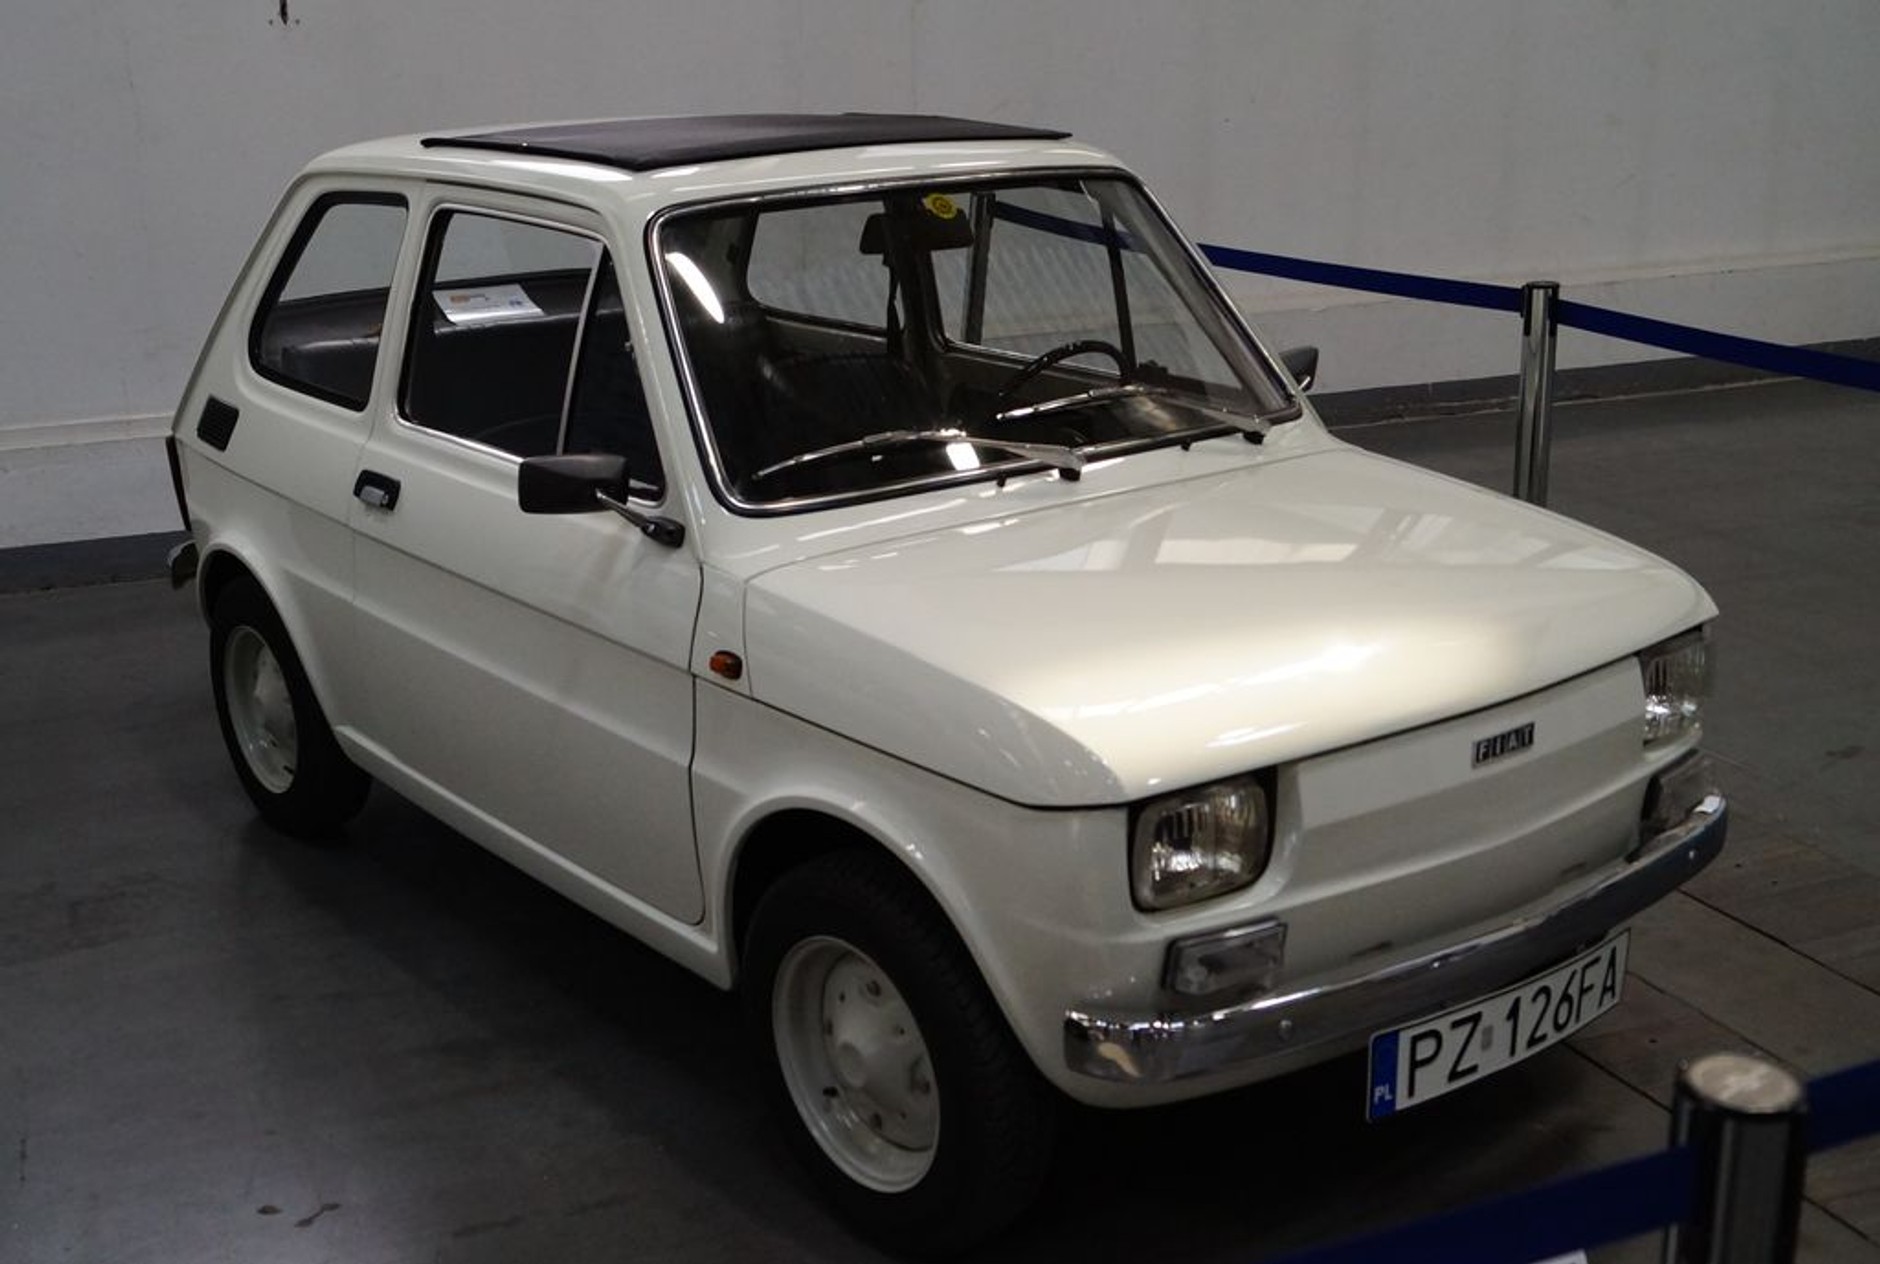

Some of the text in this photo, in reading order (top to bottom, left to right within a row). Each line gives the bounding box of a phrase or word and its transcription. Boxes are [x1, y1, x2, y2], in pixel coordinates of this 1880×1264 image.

[1475, 722, 1534, 763] FIAT
[1408, 946, 1617, 1098] PZ 126FA
[1374, 1083, 1393, 1104] PL
